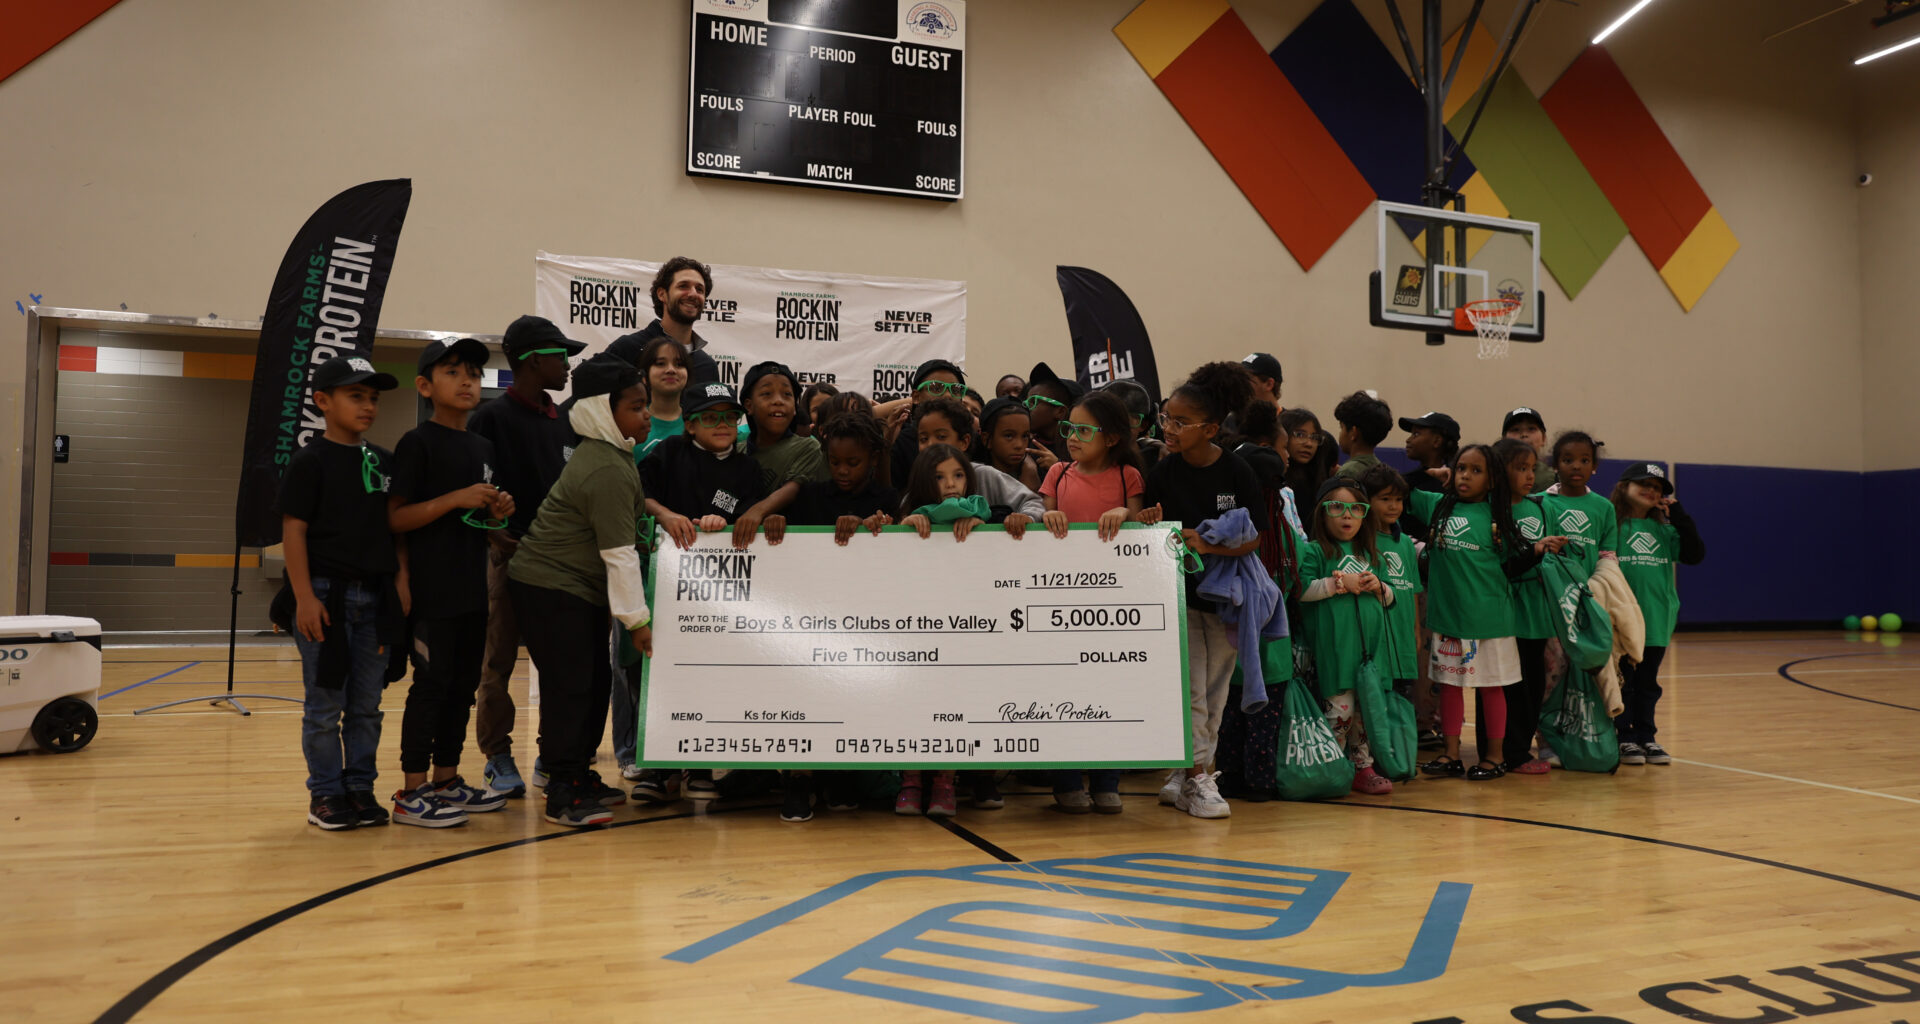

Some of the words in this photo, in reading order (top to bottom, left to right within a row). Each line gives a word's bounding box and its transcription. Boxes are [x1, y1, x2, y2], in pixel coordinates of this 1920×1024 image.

[710, 21, 768, 47] HOME
[809, 45, 856, 64] PERIOD
[891, 46, 952, 72] GUEST
[700, 94, 744, 112] FOULS
[788, 105, 839, 123] PLAYER
[843, 111, 876, 128] FOUL
[917, 120, 957, 137] FOULS
[696, 152, 741, 170] SCORE
[806, 163, 853, 181] MATCH
[915, 175, 956, 192] SCORE
[570, 280, 640, 308] ROCKIN'
[704, 299, 738, 311] EVER
[776, 297, 842, 322] ROCKIN'
[570, 303, 637, 329] PROTEIN
[884, 310, 933, 323] NEVER
[776, 319, 839, 342] PROTEIN
[874, 321, 930, 334] SETTLE
[873, 369, 915, 393] ROCK
[1113, 544, 1150, 556] 1001
[679, 554, 756, 579] ROCKIN'
[994, 579, 1021, 588] DATE
[1031, 572, 1117, 586] 11/21/2025
[677, 579, 751, 601] PROTEIN
[678, 615, 696, 623] PAY
[697, 615, 709, 623] TO
[711, 615, 729, 623] THE
[735, 616, 777, 633] Boys
[782, 616, 793, 630] &
[799, 615, 837, 630] Girls
[842, 615, 891, 630] Clubs
[895, 615, 913, 630] of
[917, 615, 944, 630] the
[949, 615, 998, 632] Valley
[1010, 608, 1024, 632] $
[1050, 608, 1141, 629] 5,000.00
[680, 625, 711, 633] ORDER
[713, 625, 727, 633] OF
[812, 648, 848, 662] Five
[853, 648, 939, 662] Thousand
[1080, 651, 1148, 663] DOLLARS
[671, 712, 703, 721] MEMO
[744, 710, 759, 720] Ks
[762, 710, 778, 720] for
[780, 710, 806, 721] Kids
[933, 713, 963, 722] FROM
[998, 701, 1053, 722] Rockin'
[1056, 701, 1112, 720] Protein
[993, 738, 1040, 753] 1000
